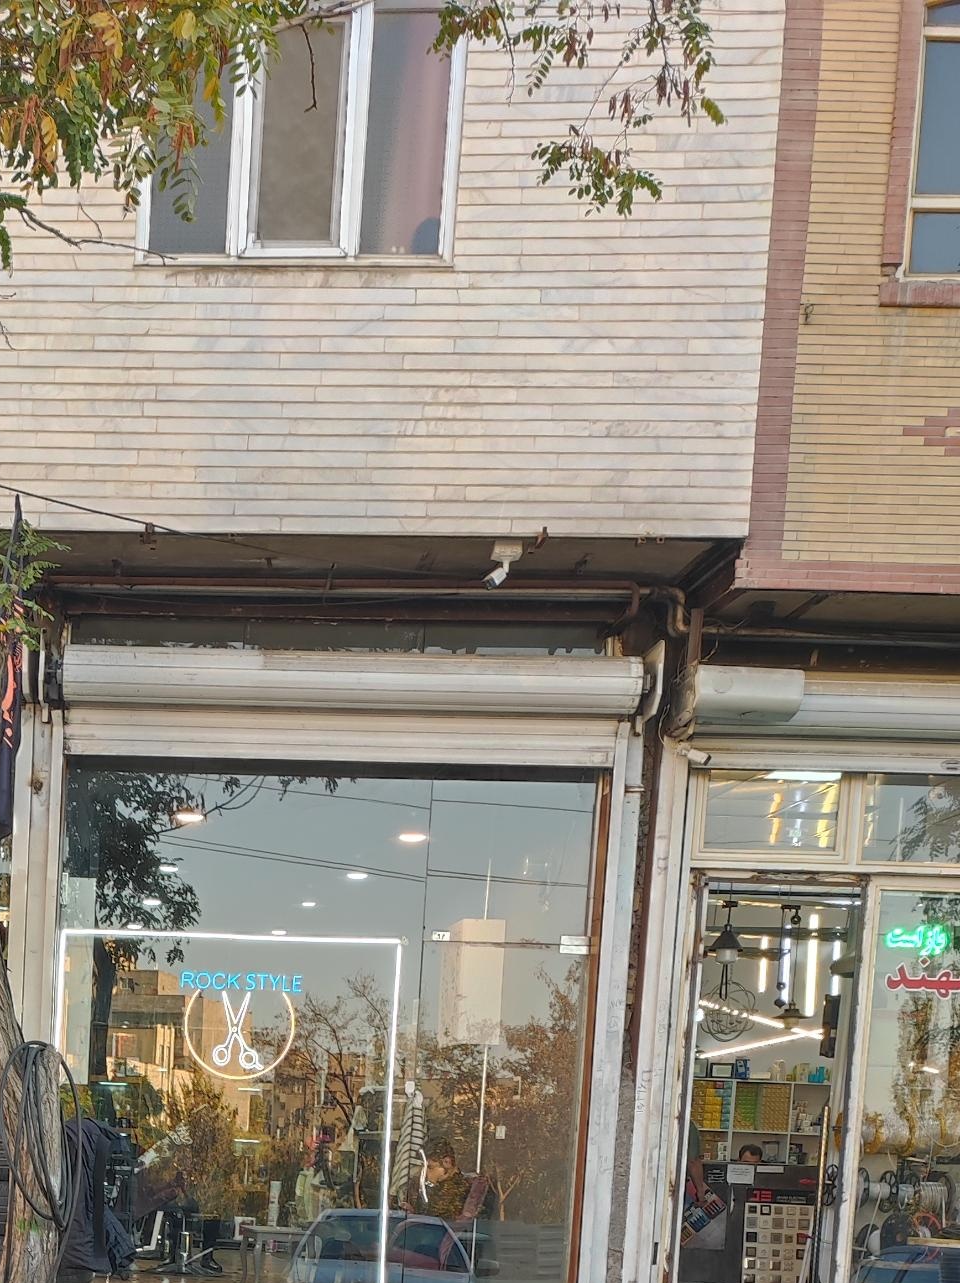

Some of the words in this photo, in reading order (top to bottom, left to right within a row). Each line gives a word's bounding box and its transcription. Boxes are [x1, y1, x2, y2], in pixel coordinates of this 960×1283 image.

[180, 970, 242, 992] ROCK
[245, 972, 303, 994] STYLE
[885, 957, 960, 999] هند
